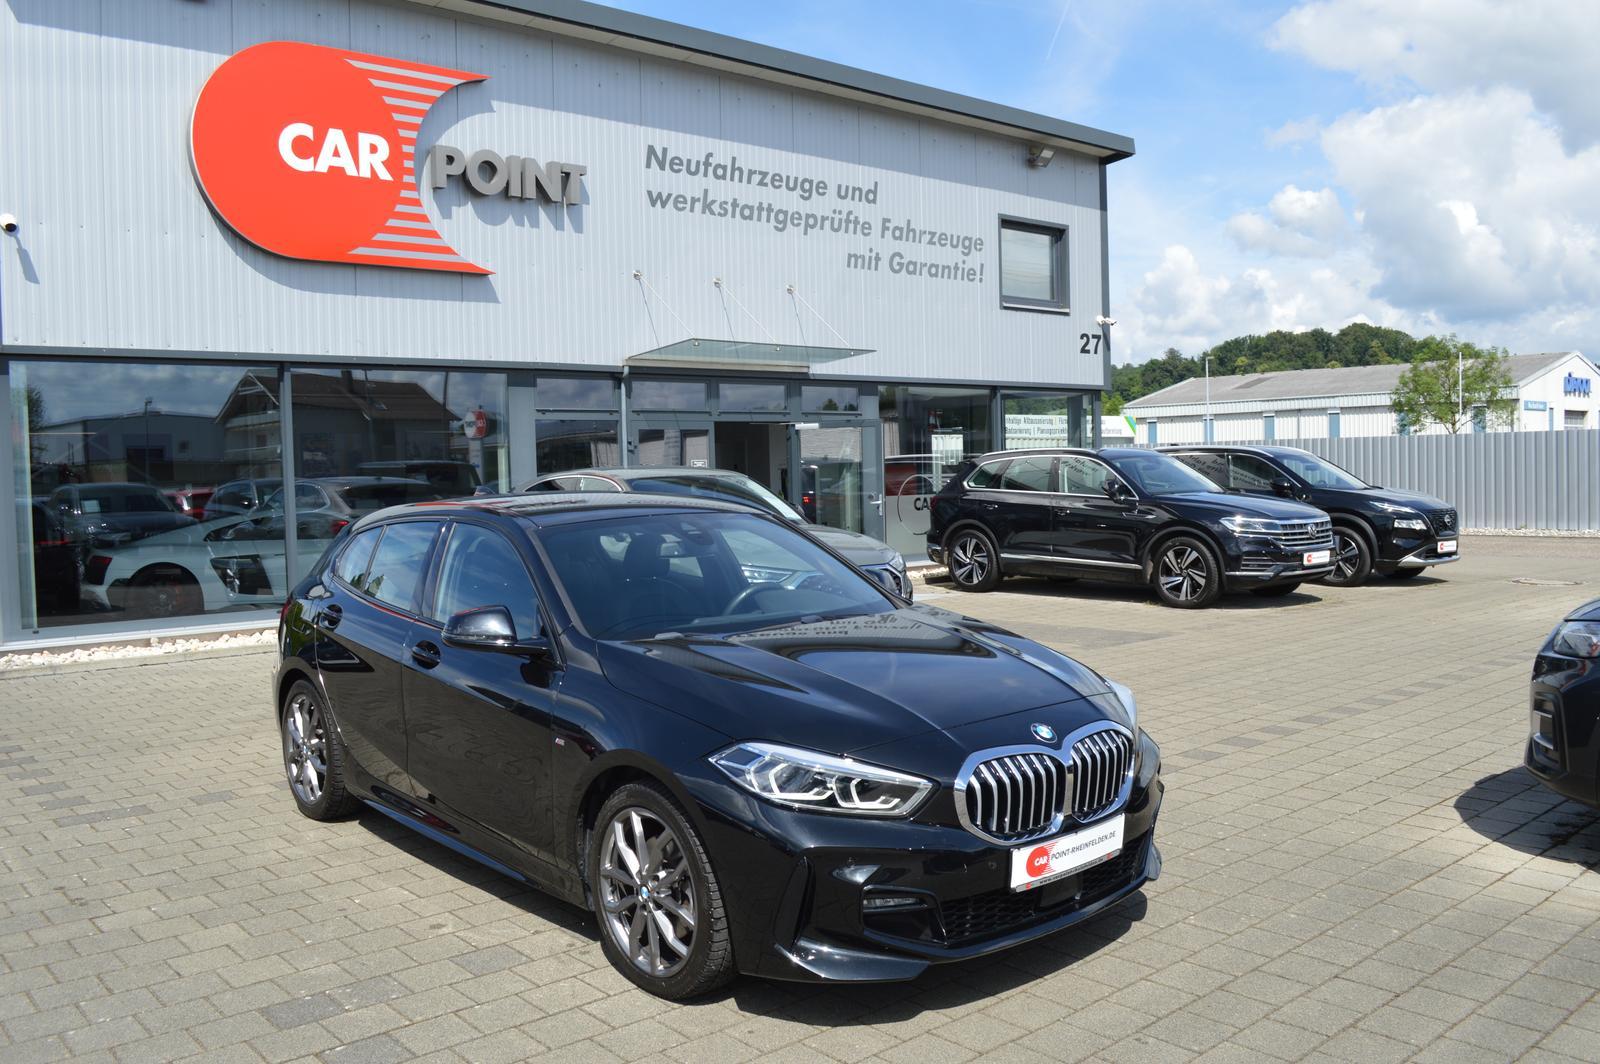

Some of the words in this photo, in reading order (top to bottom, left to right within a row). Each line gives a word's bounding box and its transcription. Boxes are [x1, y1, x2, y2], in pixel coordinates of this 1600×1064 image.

[278, 122, 393, 181] CAR
[430, 145, 587, 206] POINT
[645, 143, 829, 201] Neufahrzeuge
[836, 181, 879, 205] und
[646, 187, 872, 237] werkstattgeprüfte
[880, 217, 985, 257] Fahrzeuge
[846, 247, 882, 272] mit
[888, 250, 985, 284] Garantie!
[1079, 332, 1102, 355] 27
[913, 497, 932, 511] CA
[1033, 855, 1049, 867] CAR
[1050, 830, 1117, 861] POINT-RHEINFELDEN.DE
